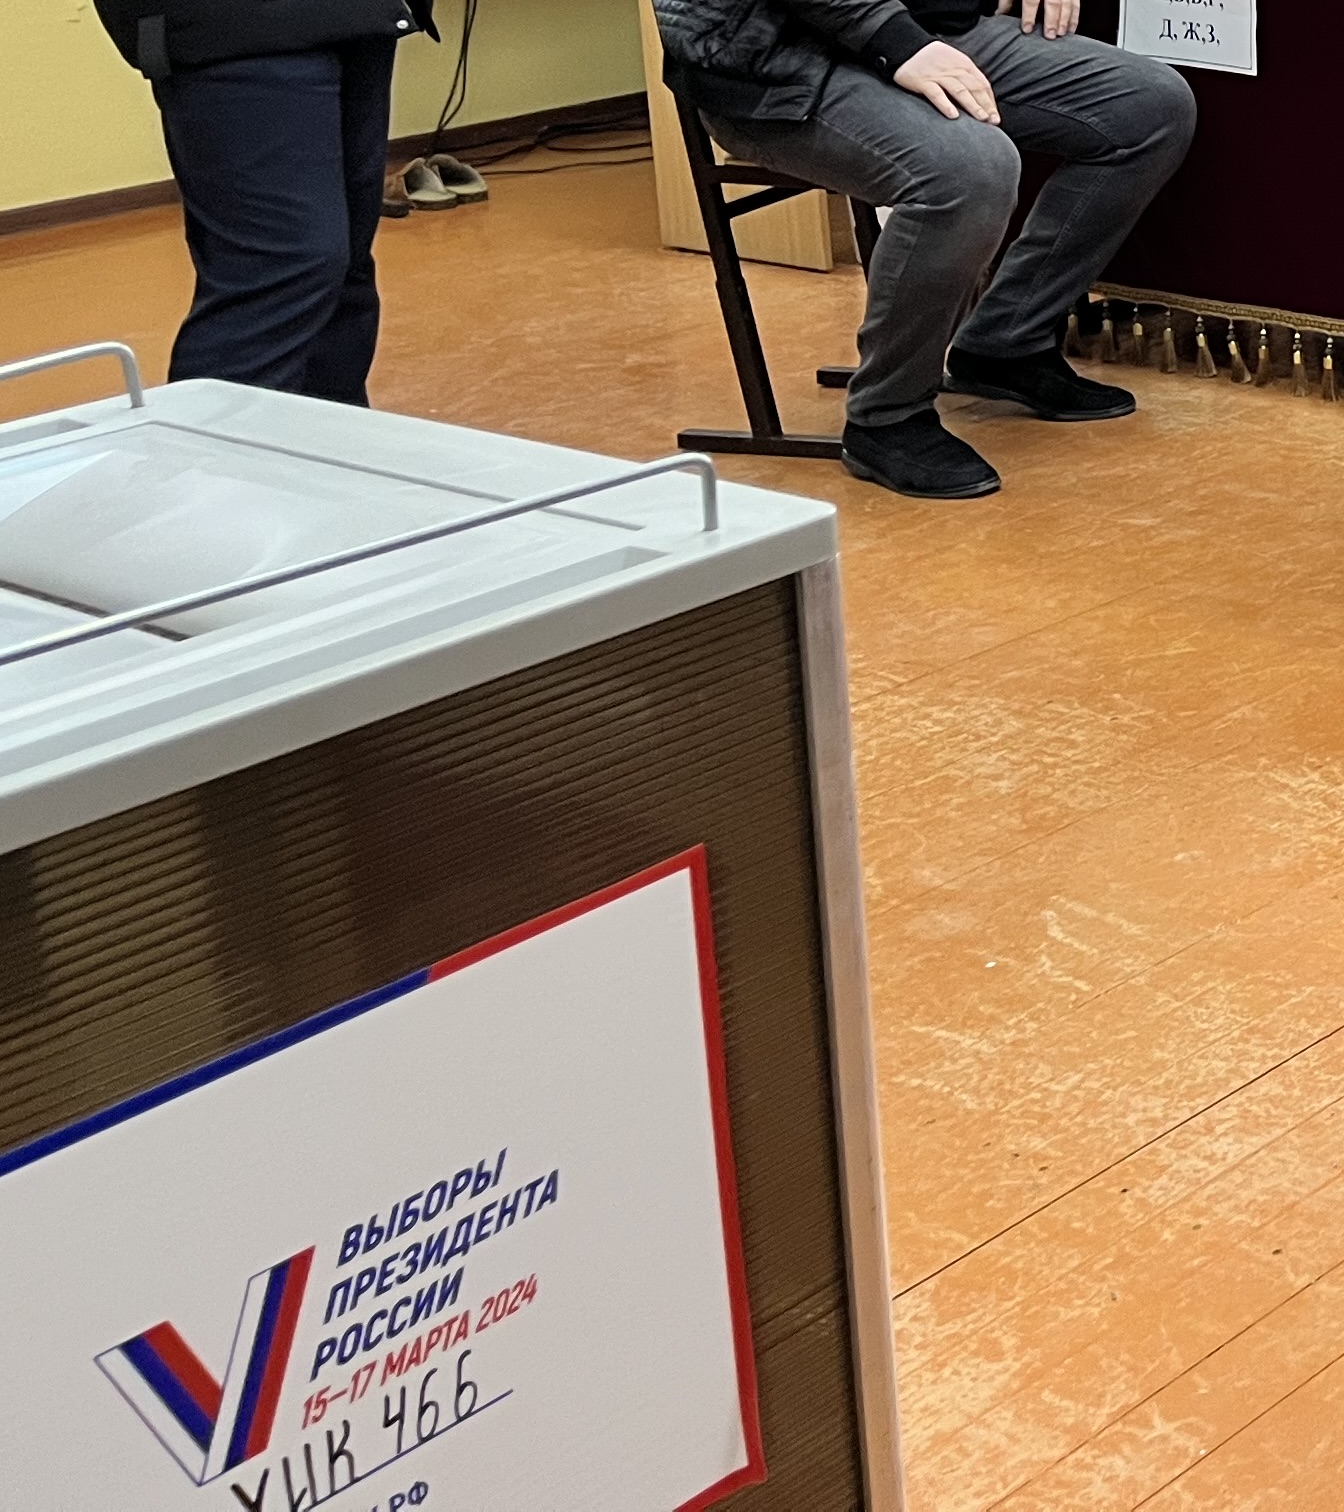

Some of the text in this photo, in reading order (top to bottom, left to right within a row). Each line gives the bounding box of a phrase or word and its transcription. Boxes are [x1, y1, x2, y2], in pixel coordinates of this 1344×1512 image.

[323, 1168, 560, 1326] ПРЕЗИДЕНТА
[336, 1146, 508, 1269] ВЫБОРЫ
[309, 1265, 466, 1384] РОССИИ
[380, 1309, 471, 1388] МАРТА
[474, 1272, 539, 1334] 2024
